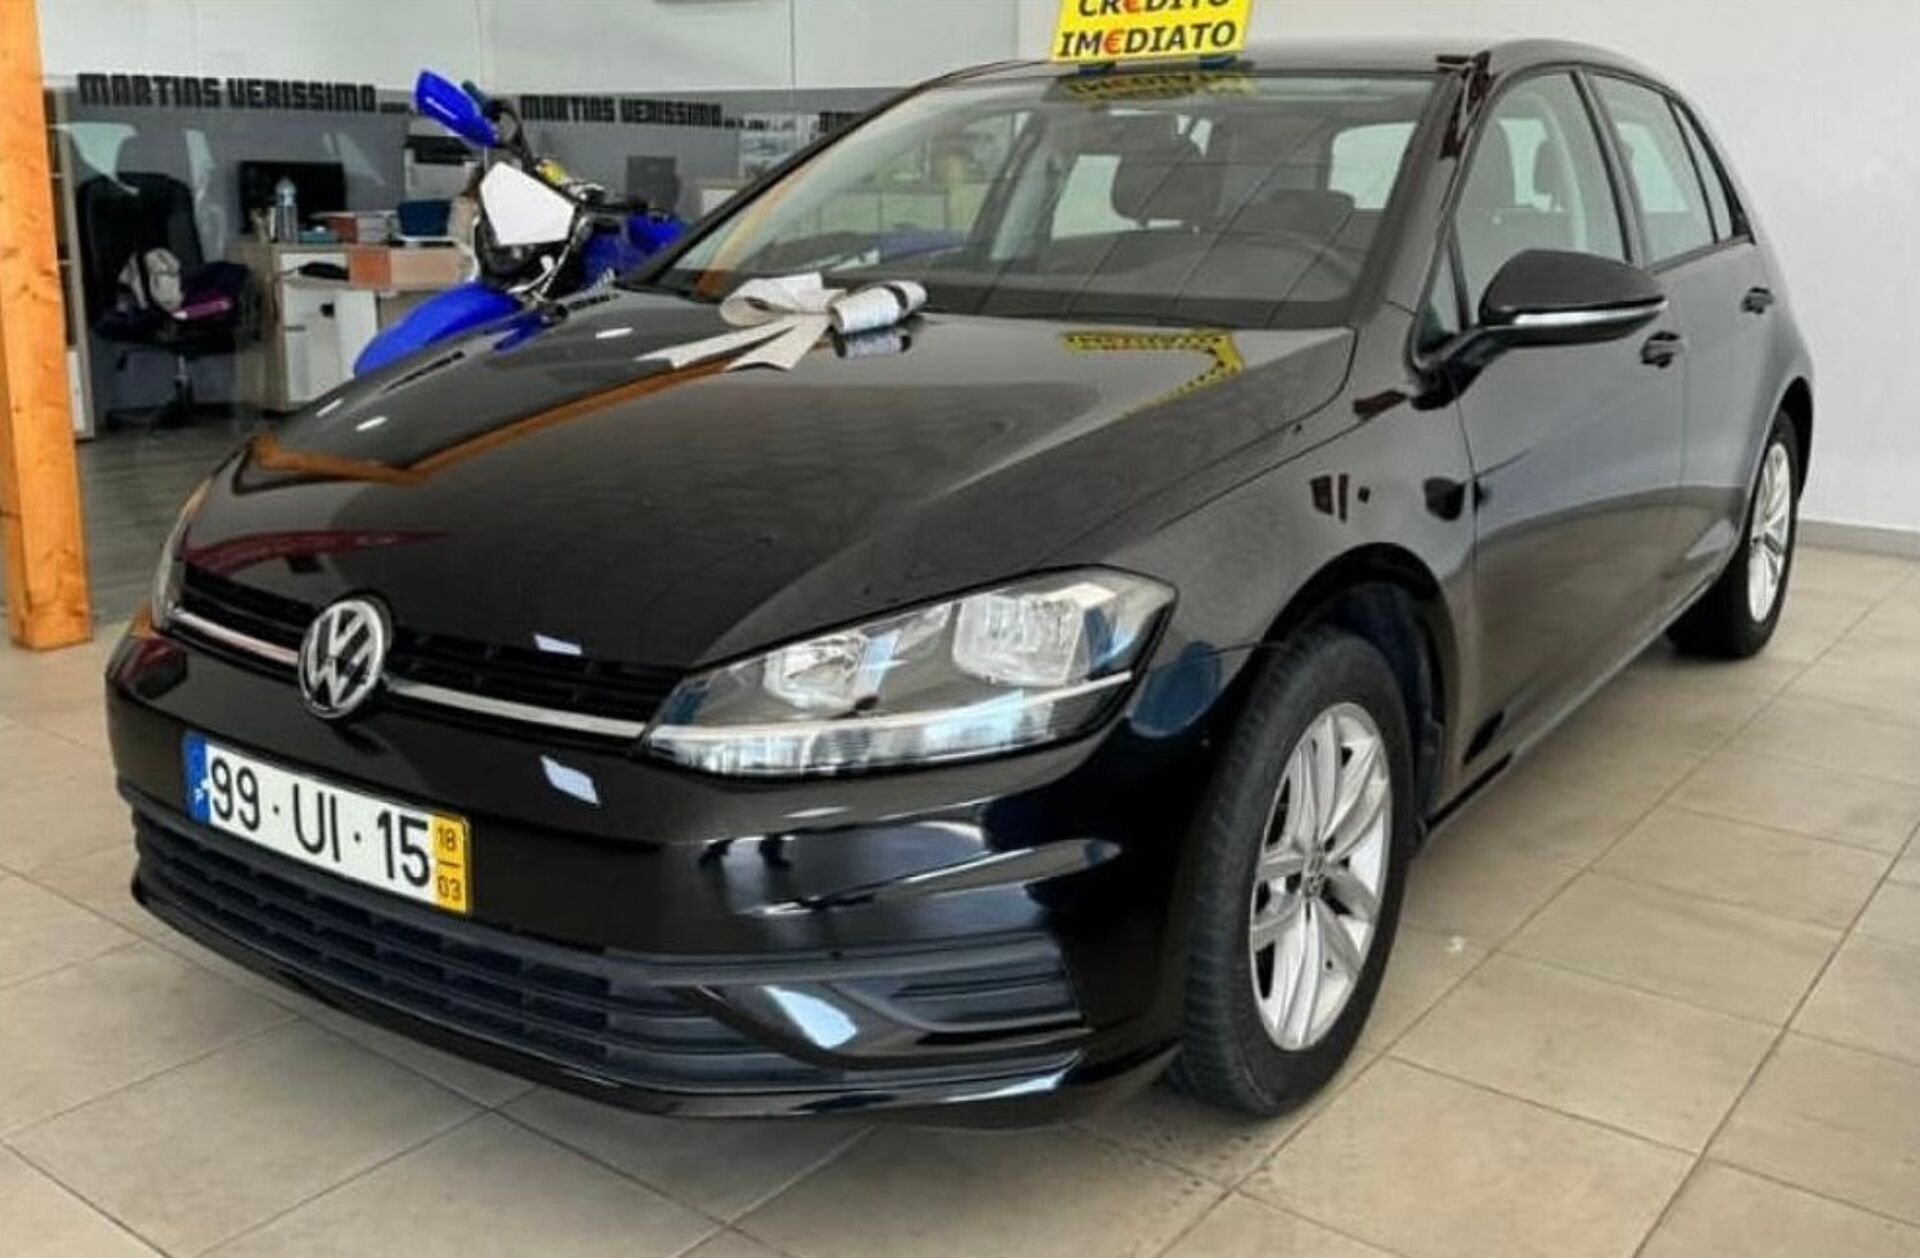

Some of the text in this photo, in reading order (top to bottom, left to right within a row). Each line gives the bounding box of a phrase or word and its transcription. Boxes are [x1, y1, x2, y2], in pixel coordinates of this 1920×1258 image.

[77, 73, 376, 113] MARTINS VERISSIMO
[519, 94, 615, 122] MARTINS
[620, 98, 723, 128] VERISSIMO
[436, 826, 457, 852] 18
[437, 875, 461, 901] 03
